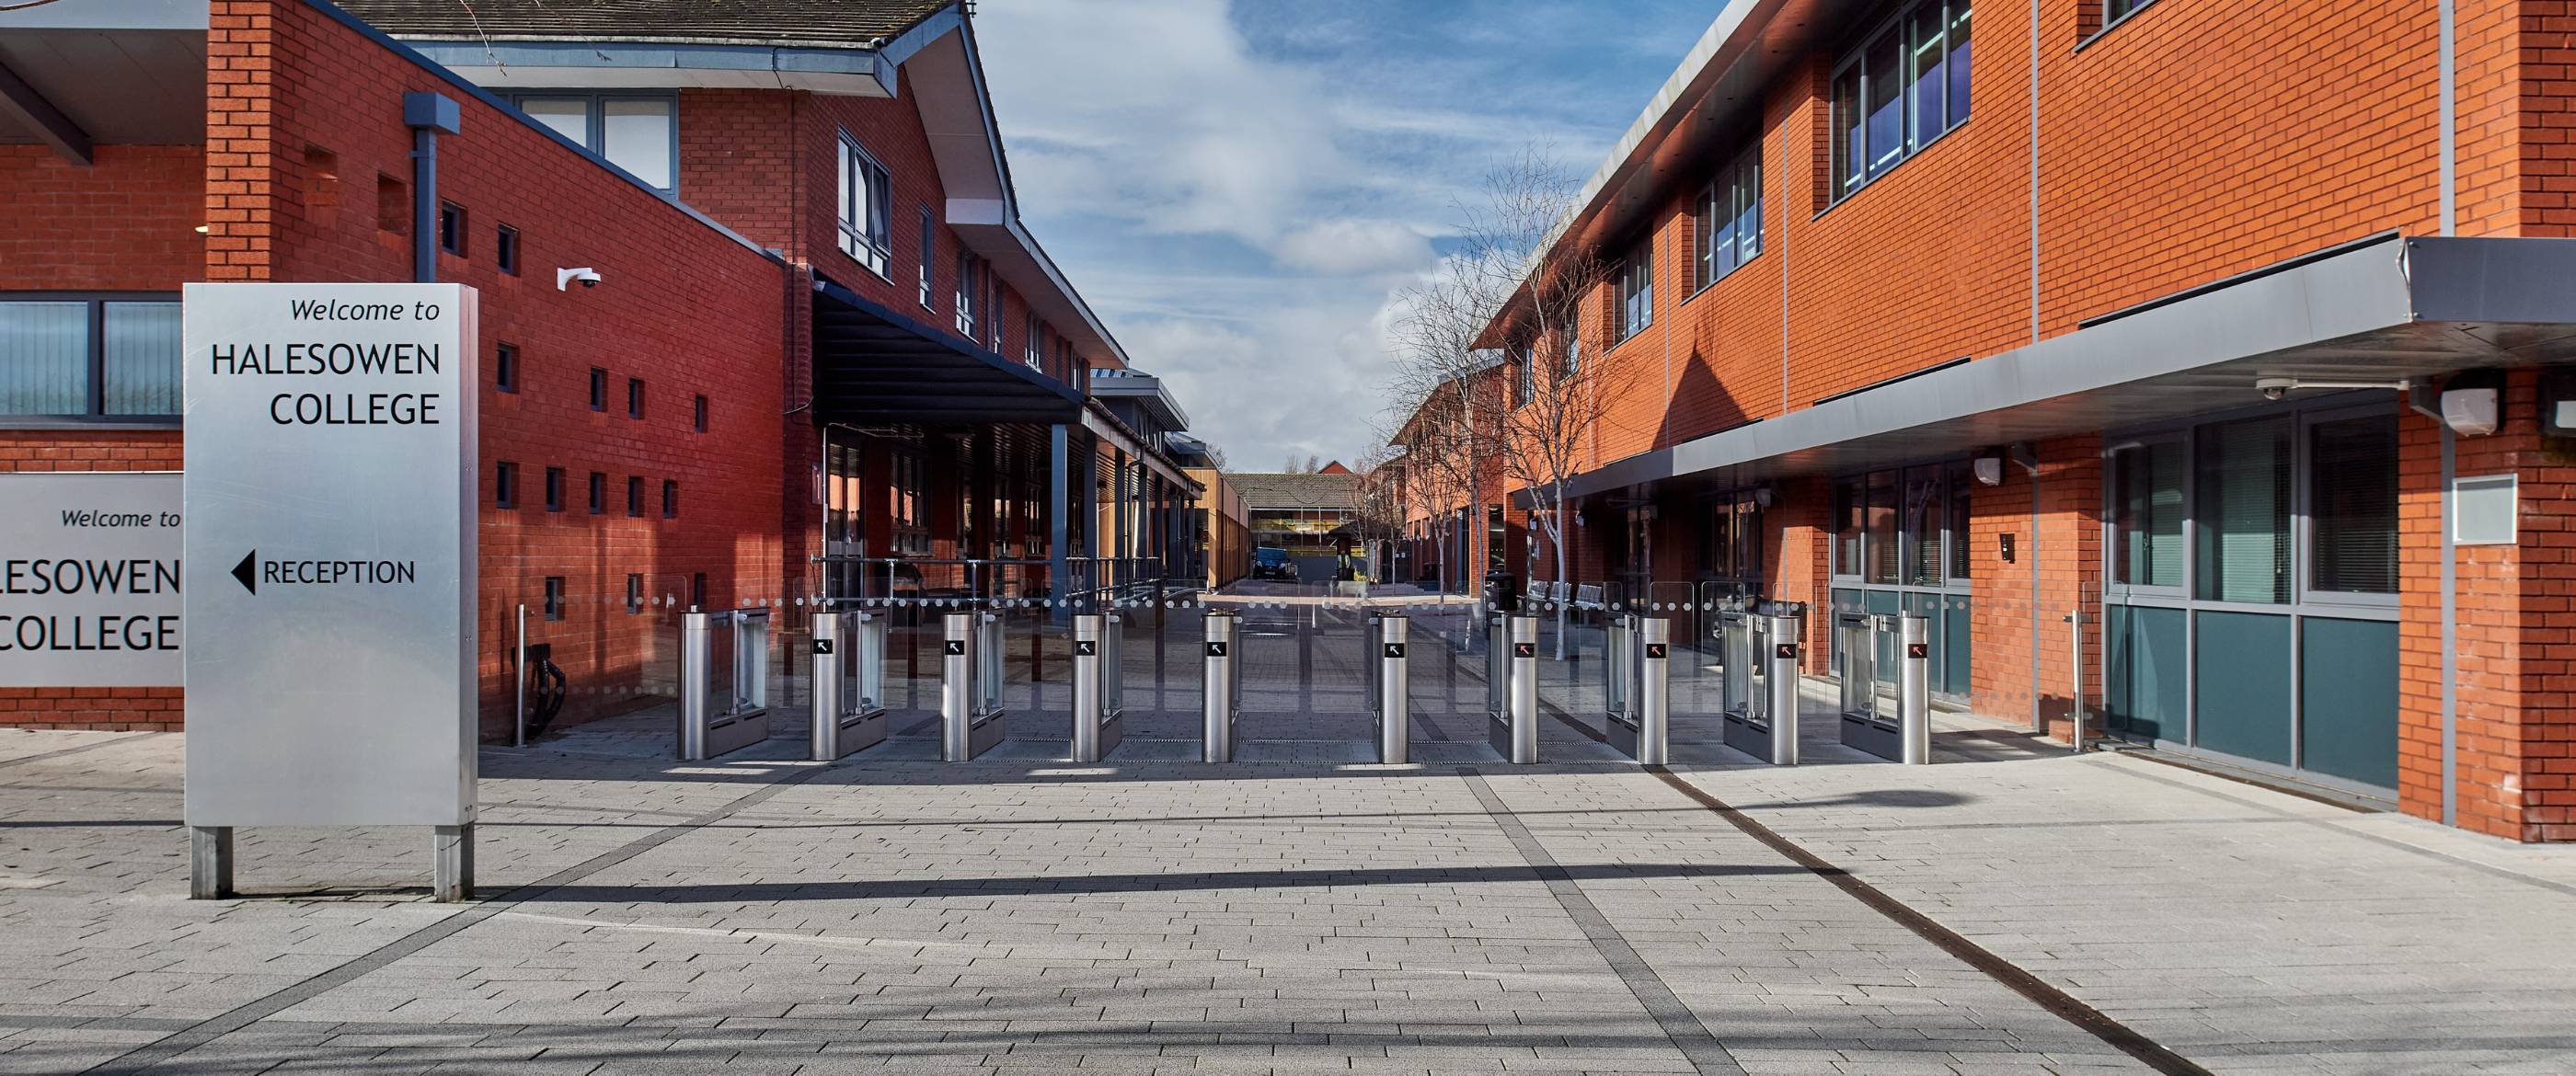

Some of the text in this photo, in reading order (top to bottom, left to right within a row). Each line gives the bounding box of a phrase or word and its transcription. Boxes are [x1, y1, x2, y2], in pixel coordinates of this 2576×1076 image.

[291, 299, 440, 321] Welcome to
[212, 343, 440, 375] HALESOWEN
[270, 394, 440, 425] COLLEGE
[62, 509, 181, 528] Welcome to
[0, 559, 180, 594] ESOWEN
[264, 561, 415, 584] RECEPTION
